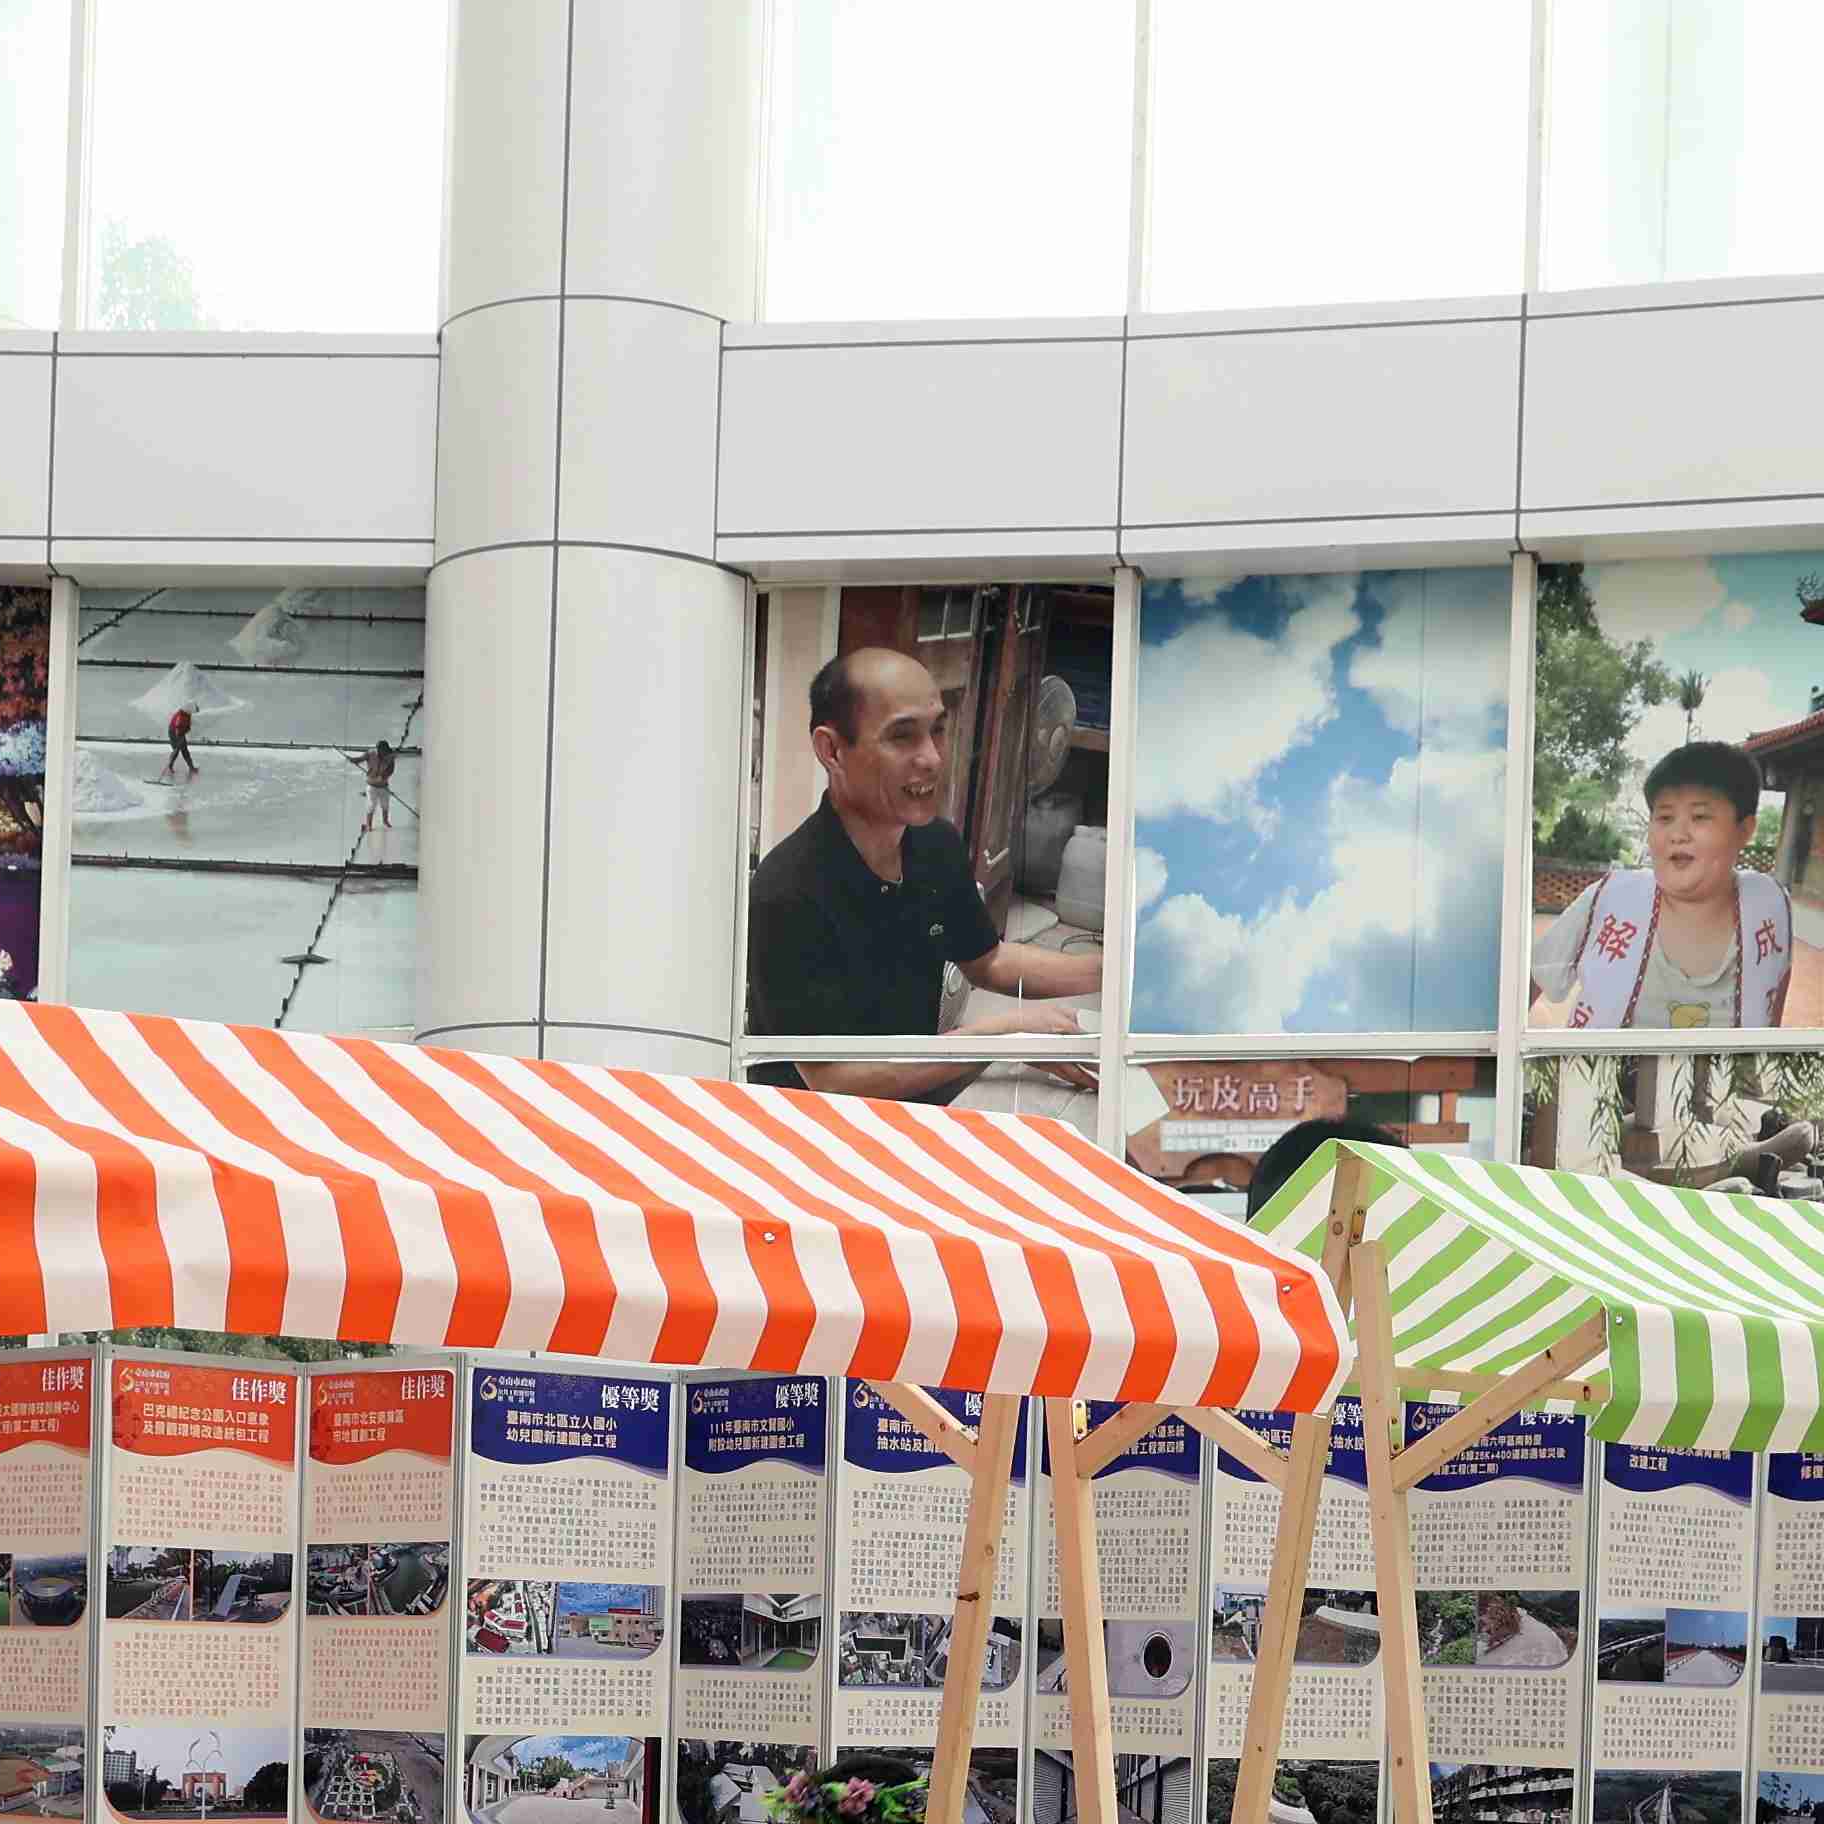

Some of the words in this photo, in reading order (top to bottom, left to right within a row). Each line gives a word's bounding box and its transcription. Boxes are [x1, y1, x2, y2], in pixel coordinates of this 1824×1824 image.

[1173, 1075, 1314, 1114] 玩皮高手
[42, 1366, 85, 1392] 佳作獎
[232, 1377, 288, 1404] 佳作獎
[401, 1375, 446, 1401] 佳作獎
[601, 1384, 659, 1412] 優等獎
[775, 1382, 819, 1408] 優等獎
[143, 1403, 270, 1425] 巴克禮紀念公園入口意象
[506, 1410, 617, 1430] 臺南市北區立人國小
[143, 1420, 270, 1444] 及景觀環境改造統包工程
[506, 1428, 617, 1448] 幼兒園新建園舍工程
